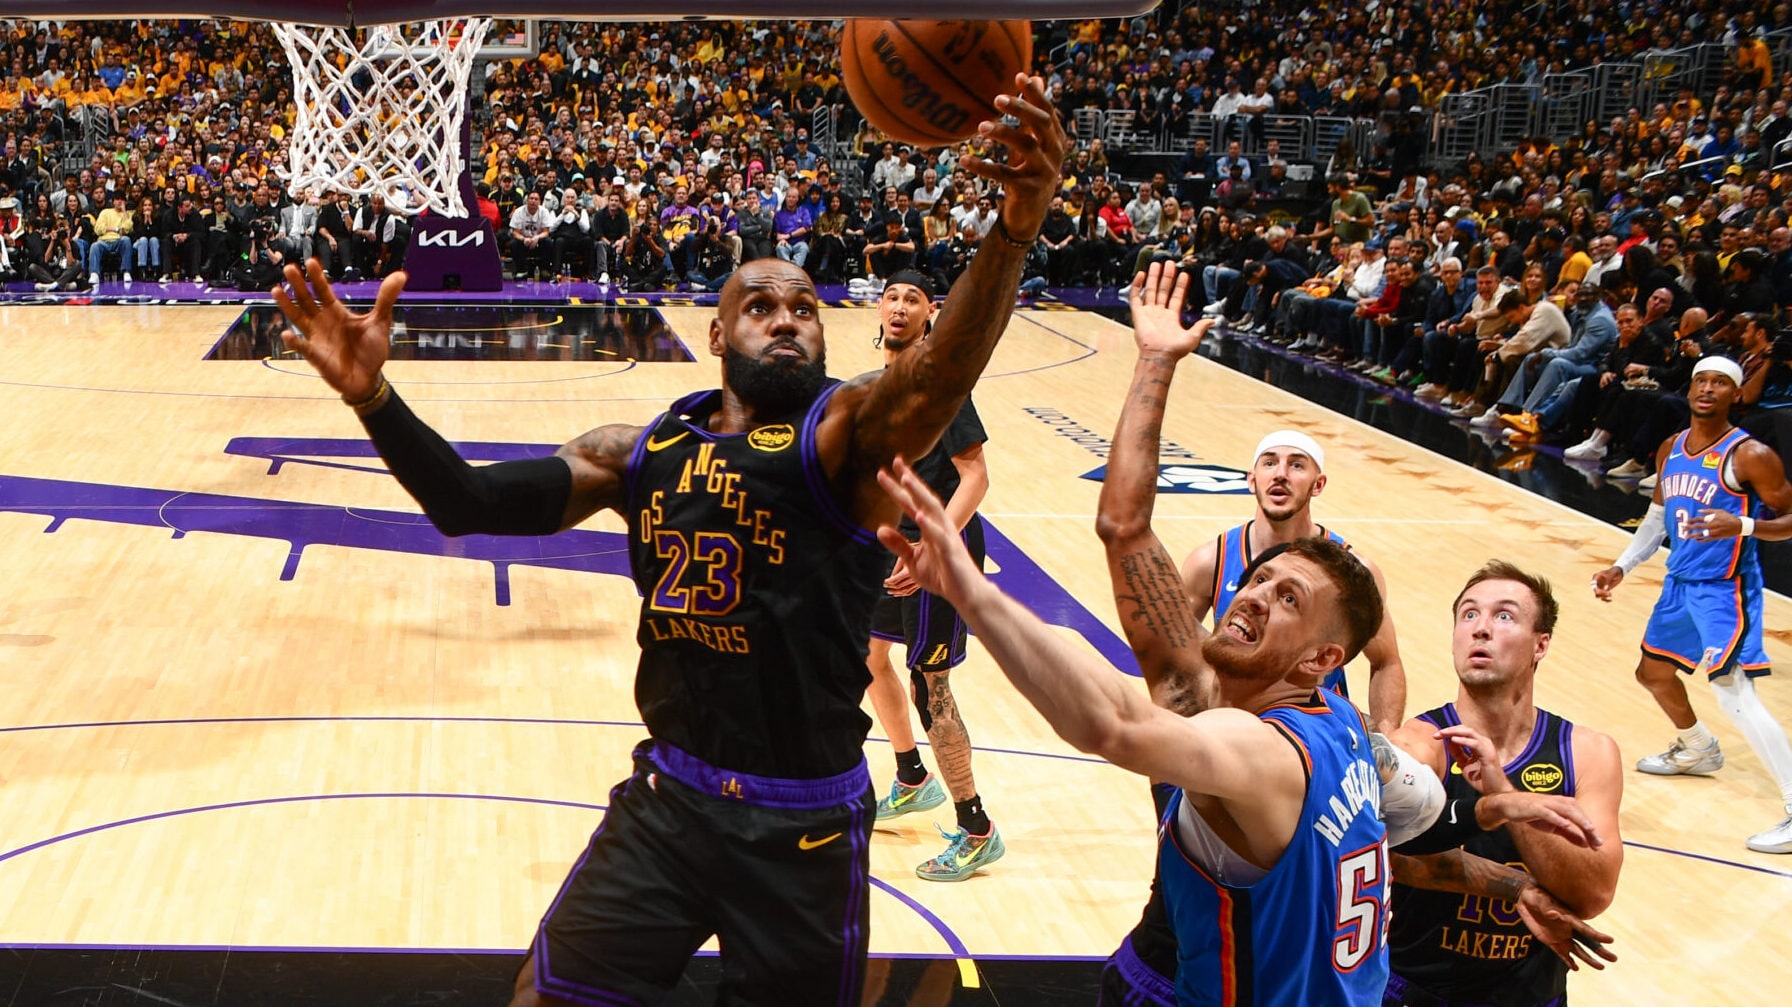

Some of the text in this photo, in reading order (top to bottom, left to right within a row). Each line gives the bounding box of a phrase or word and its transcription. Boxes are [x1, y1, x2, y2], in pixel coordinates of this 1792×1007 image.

[872, 30, 971, 132] Wilson
[418, 230, 484, 247] KIA
[753, 431, 792, 445] bibigo
[675, 442, 787, 566] ANGELES
[649, 529, 744, 617] 23
[646, 618, 750, 655] LAKERS
[721, 776, 744, 799] LAL
[1525, 771, 1560, 783] bibigo
[1440, 926, 1533, 960] LAKERS
